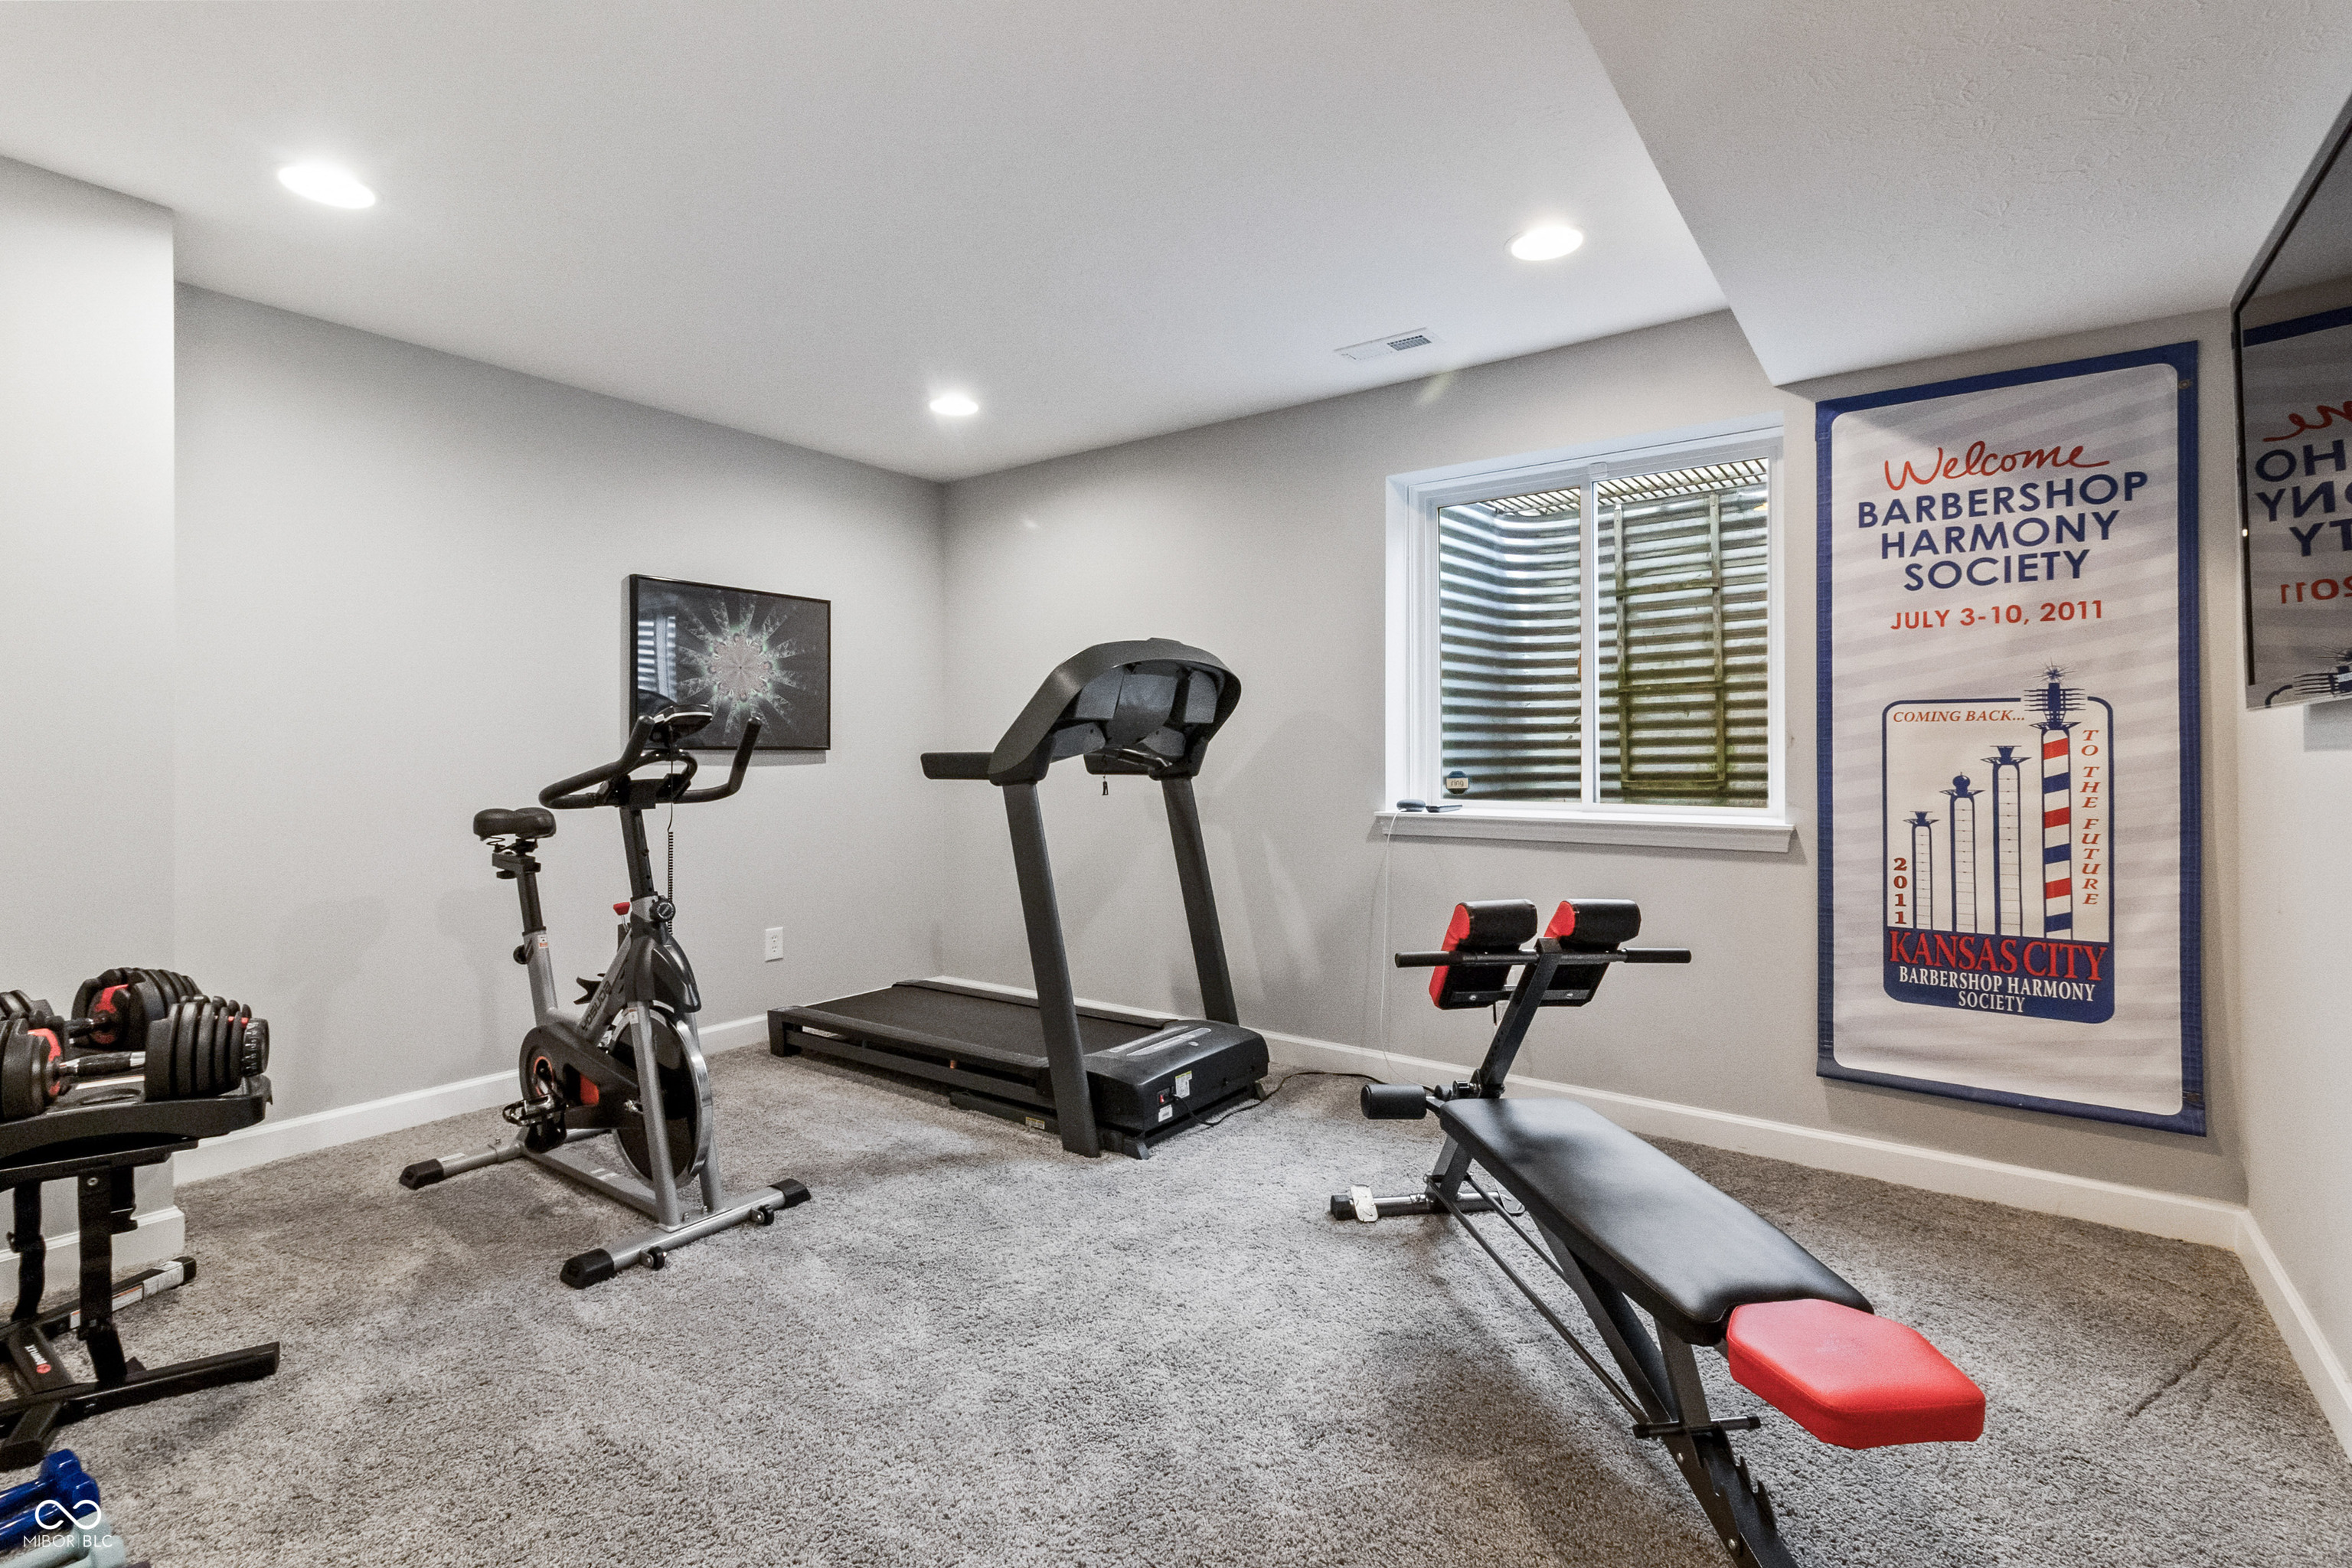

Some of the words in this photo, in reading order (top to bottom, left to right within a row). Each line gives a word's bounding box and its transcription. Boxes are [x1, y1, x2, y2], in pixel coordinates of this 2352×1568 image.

[1884, 440, 2110, 491] Welcome
[1858, 471, 2148, 528] BARBERSHOP
[1881, 509, 2120, 560] HARMONY
[1903, 549, 2091, 592] SOCIETY
[1890, 609, 1950, 630] JULY
[1959, 604, 2030, 626] 3-10,
[2040, 600, 2103, 622] 2011
[1893, 710, 1961, 723] COMING
[1965, 710, 2026, 722] BACK...
[2082, 730, 2099, 756] TO
[2079, 766, 2100, 808] THE
[2081, 818, 2100, 905] FUTURE
[1893, 857, 1908, 925] 2011
[1889, 930, 2019, 974] KANSAS
[2022, 941, 2108, 981] CITY
[1899, 966, 2003, 993] BARBERSHOP
[2007, 977, 2096, 1001] HARMONY
[1958, 991, 2026, 1013] SOCIETY
